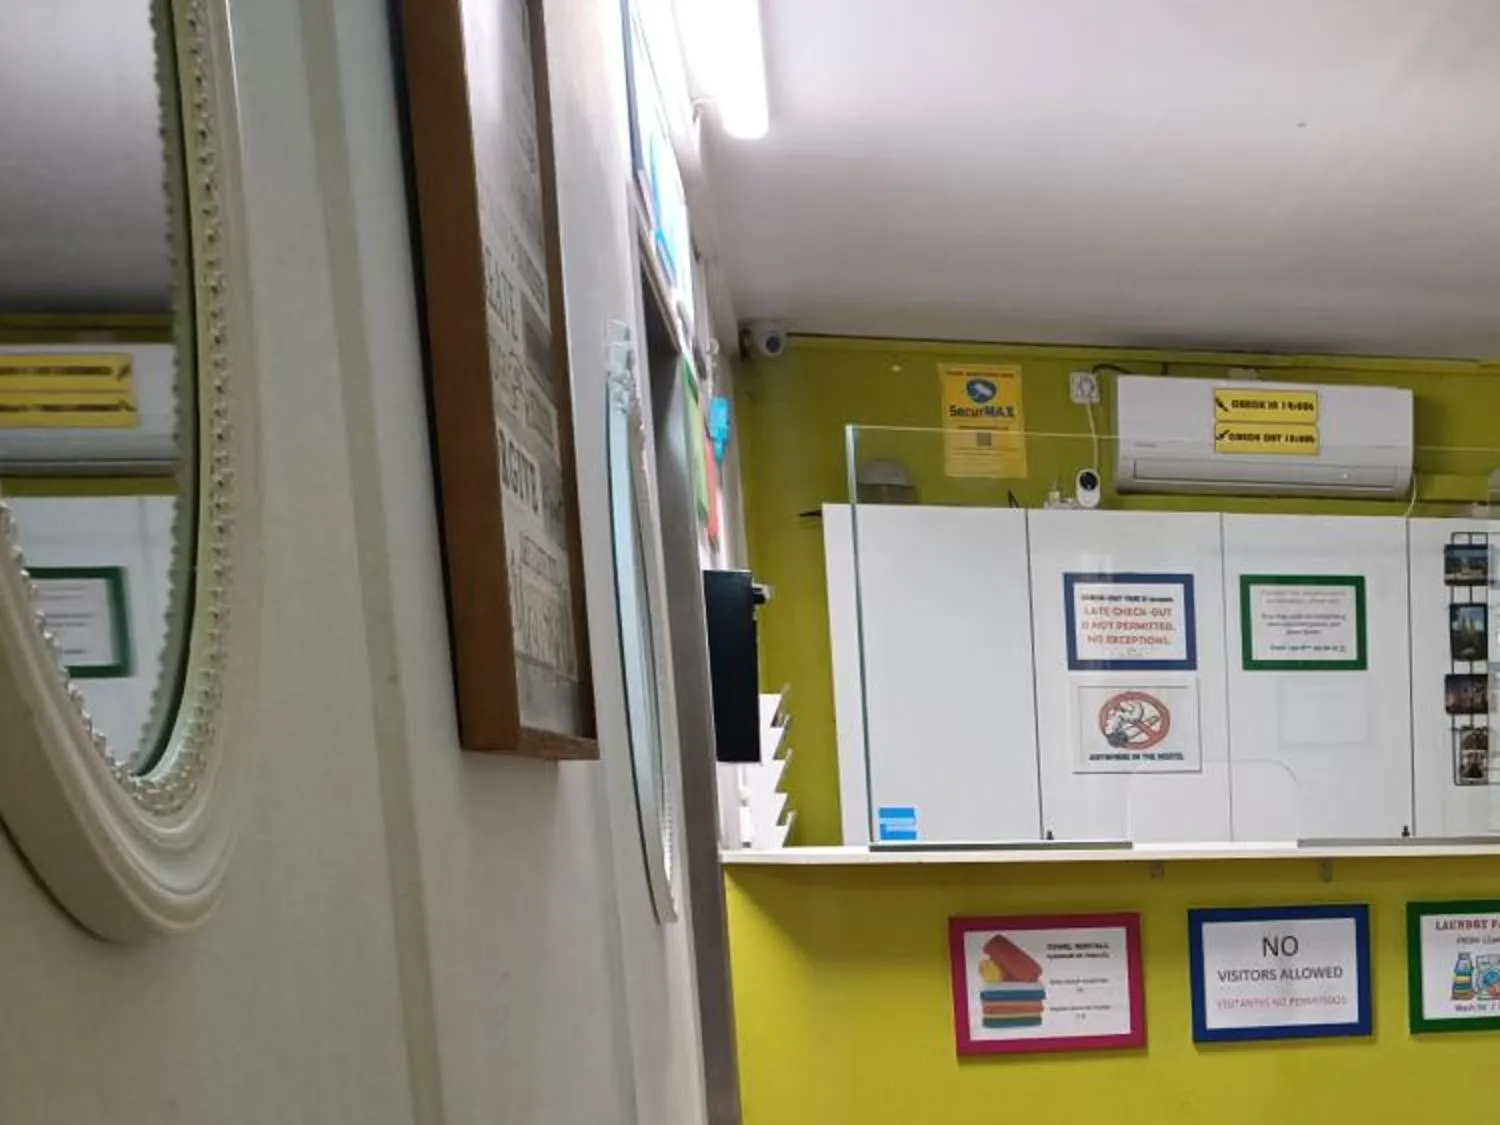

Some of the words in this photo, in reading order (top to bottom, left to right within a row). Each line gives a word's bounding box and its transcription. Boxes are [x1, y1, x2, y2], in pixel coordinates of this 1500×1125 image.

[1435, 918, 1488, 931] LAUNDRY
[1261, 935, 1299, 957] NO
[1217, 968, 1277, 983] VISITORS
[1280, 965, 1343, 981] ALLOWED
